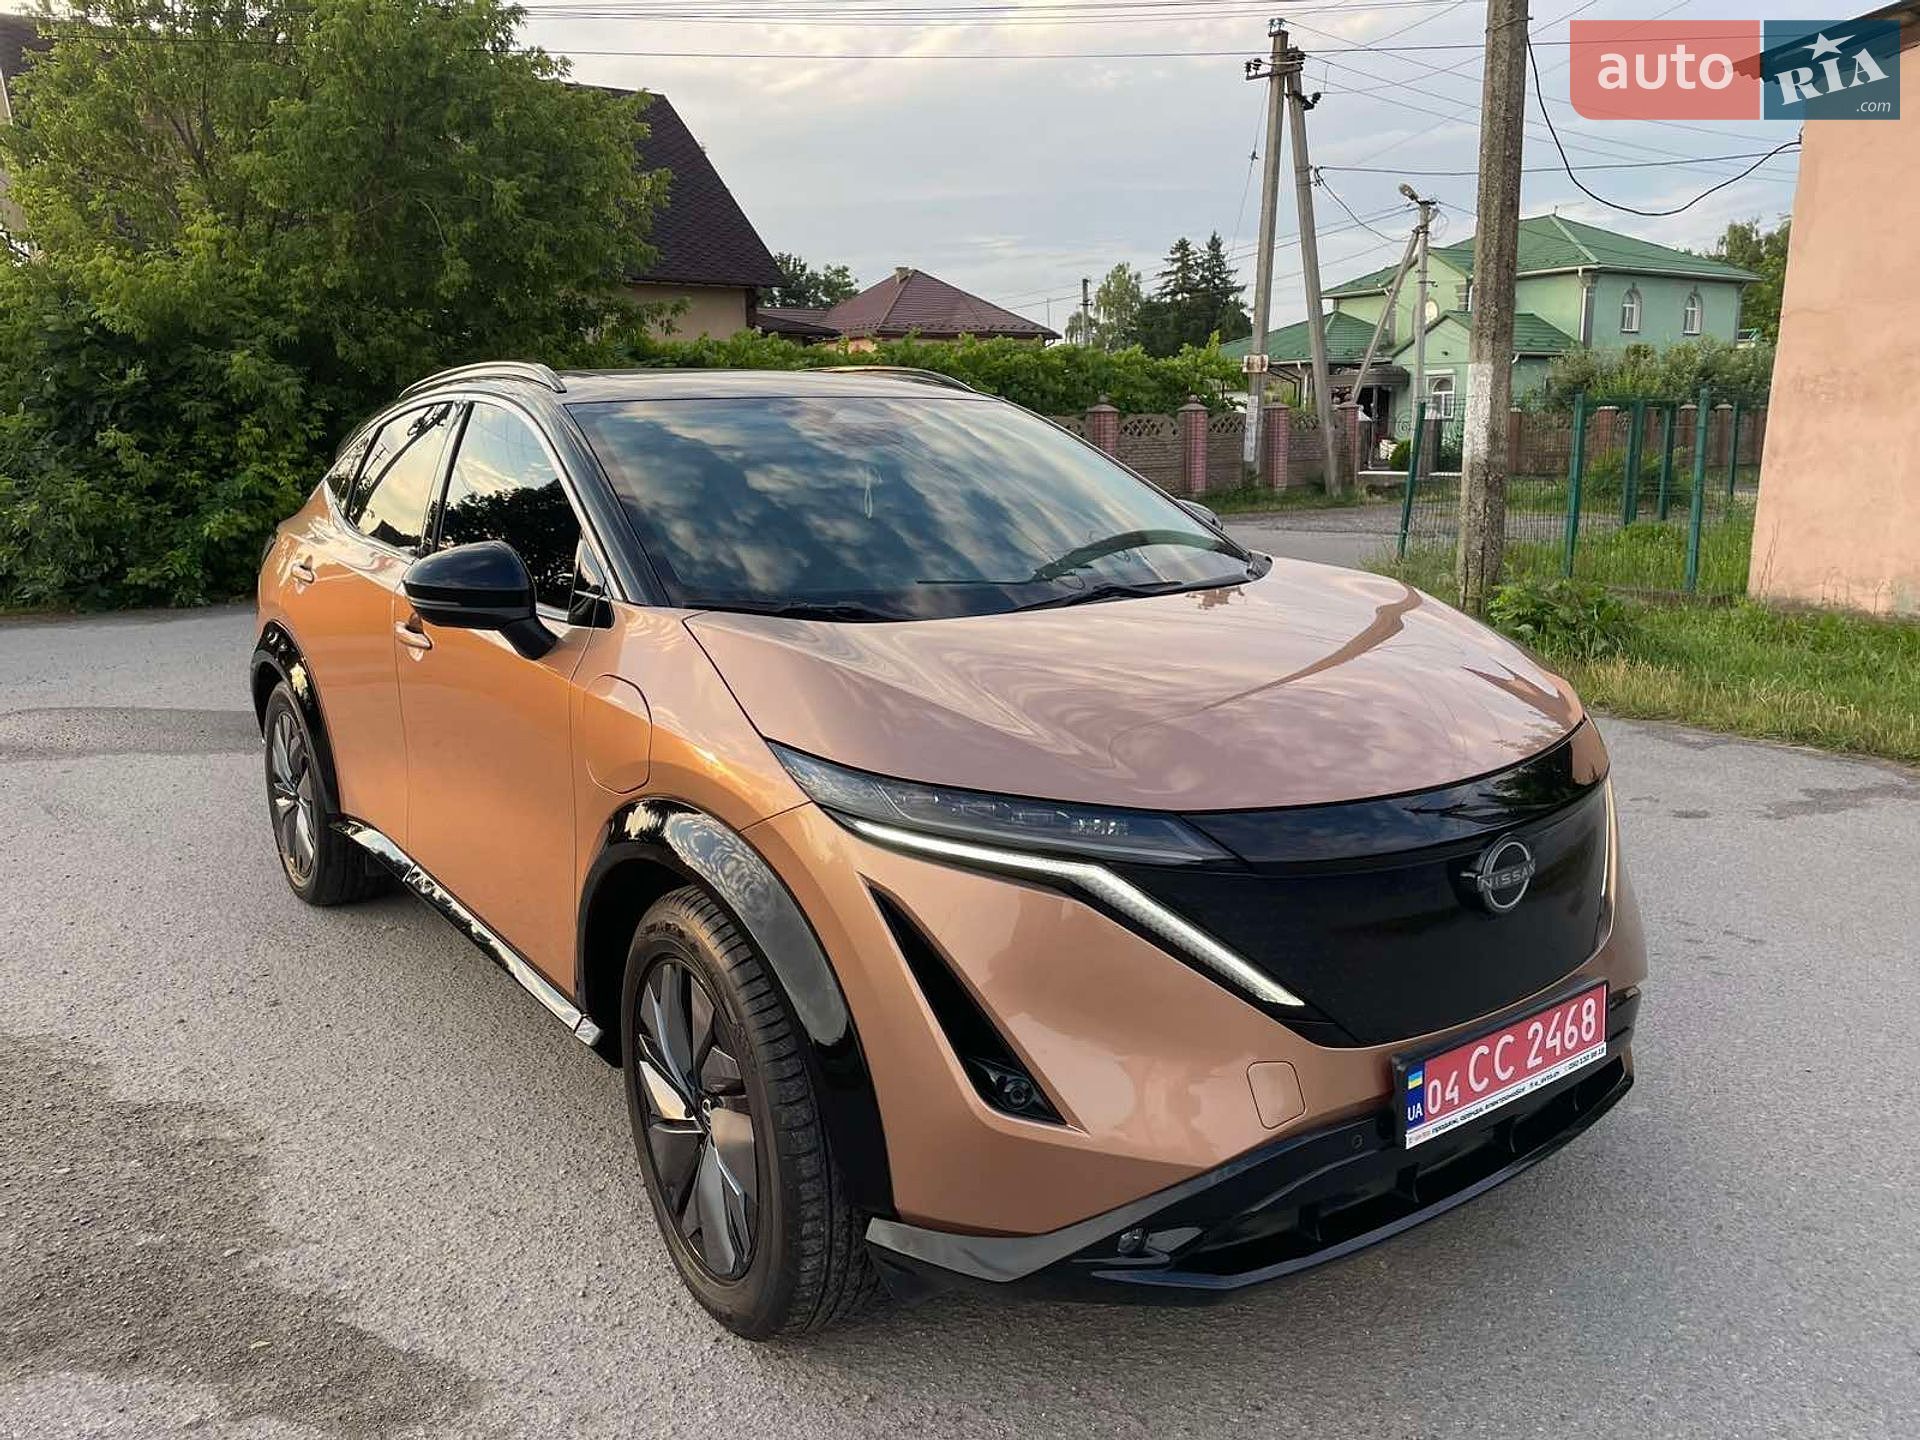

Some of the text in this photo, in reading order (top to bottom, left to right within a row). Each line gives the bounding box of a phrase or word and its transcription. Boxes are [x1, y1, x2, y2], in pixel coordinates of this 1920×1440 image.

[1427, 1070, 1459, 1115] 04
[1468, 1034, 1515, 1092] CC
[1526, 997, 1596, 1069] 2468
[1407, 1102, 1423, 1121] UA
